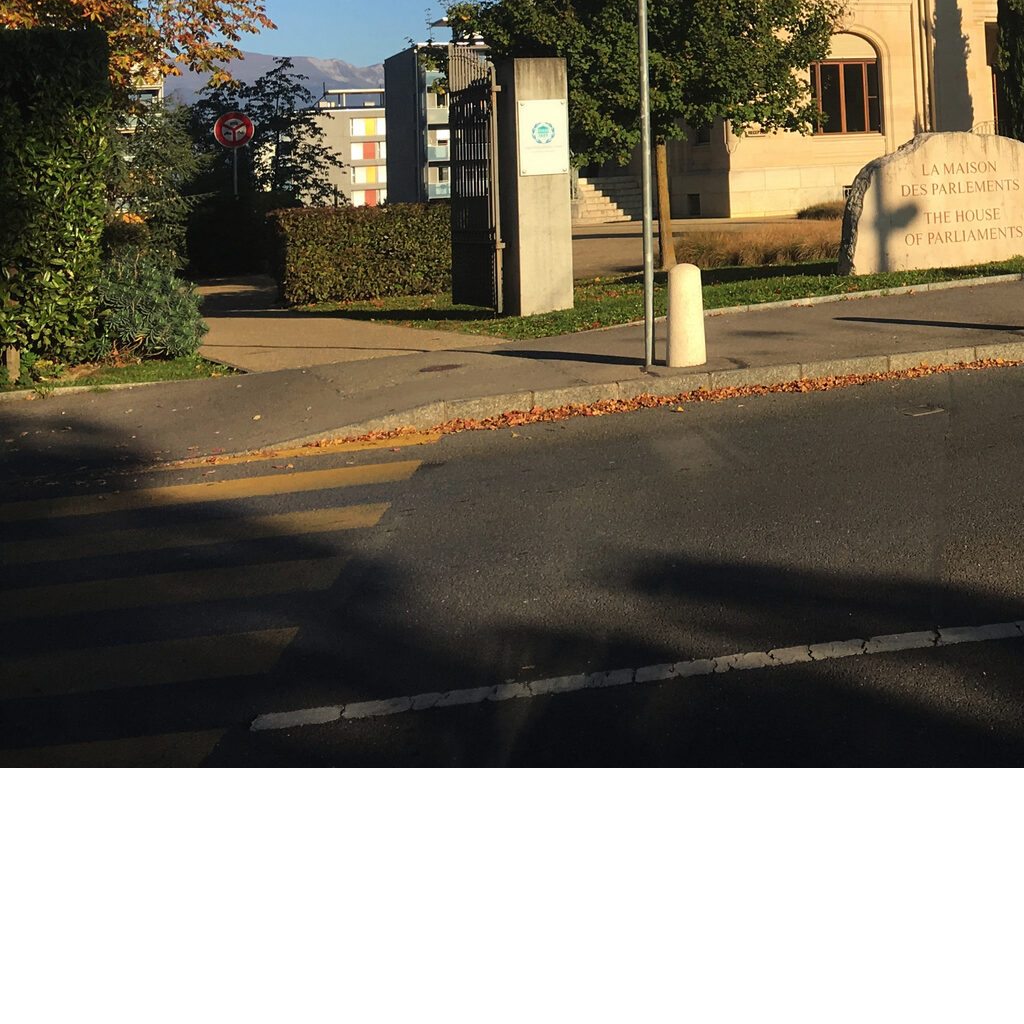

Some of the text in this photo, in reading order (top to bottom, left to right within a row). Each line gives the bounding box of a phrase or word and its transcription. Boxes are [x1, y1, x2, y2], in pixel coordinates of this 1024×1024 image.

[922, 160, 997, 176] LA MAISON
[901, 179, 1020, 197] DES PARLEMENTS
[924, 208, 1001, 224] THE HOUSE
[904, 226, 1023, 246] OF PARLIAMENTS
